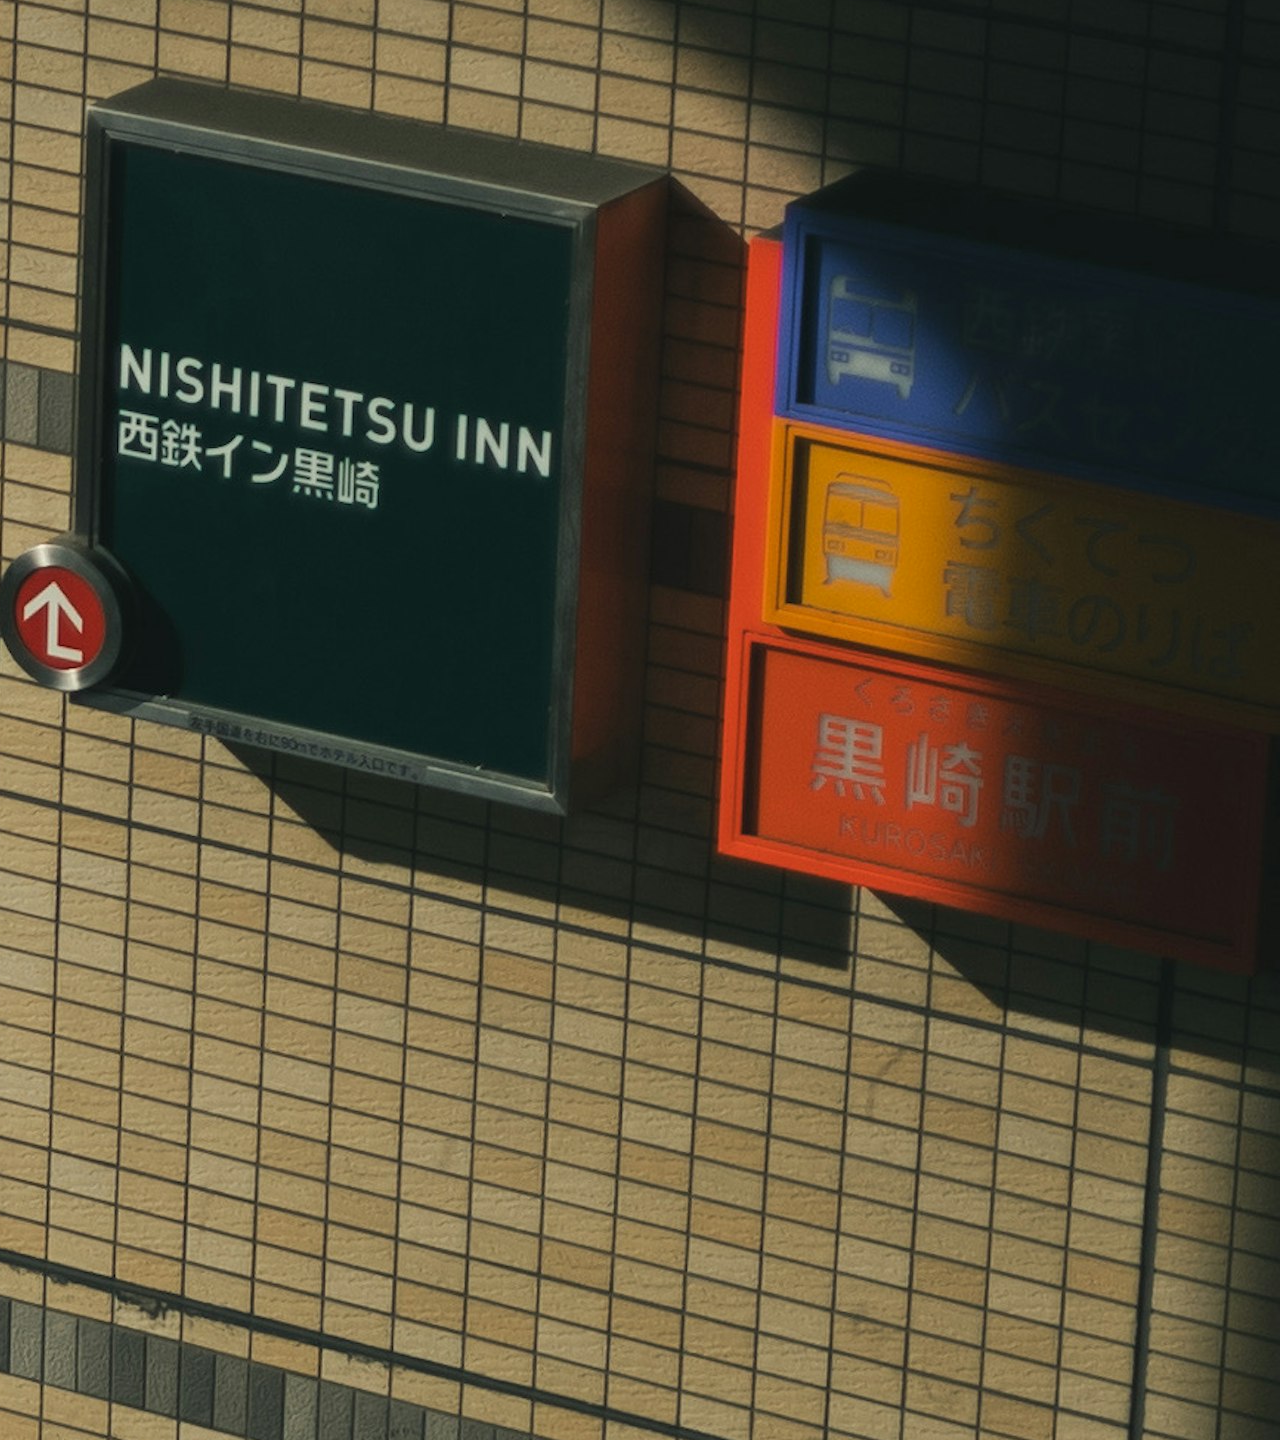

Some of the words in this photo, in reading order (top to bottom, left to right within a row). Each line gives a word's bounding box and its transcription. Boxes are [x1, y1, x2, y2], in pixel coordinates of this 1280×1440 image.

[117, 407, 382, 510] 西鉄イン黒崎
[119, 343, 436, 453] NISHITETSU
[455, 412, 554, 478] INN
[948, 485, 1198, 585] ちくてつ
[942, 562, 1256, 683] 電車のりば
[812, 712, 1181, 872] 黒崎駅前
